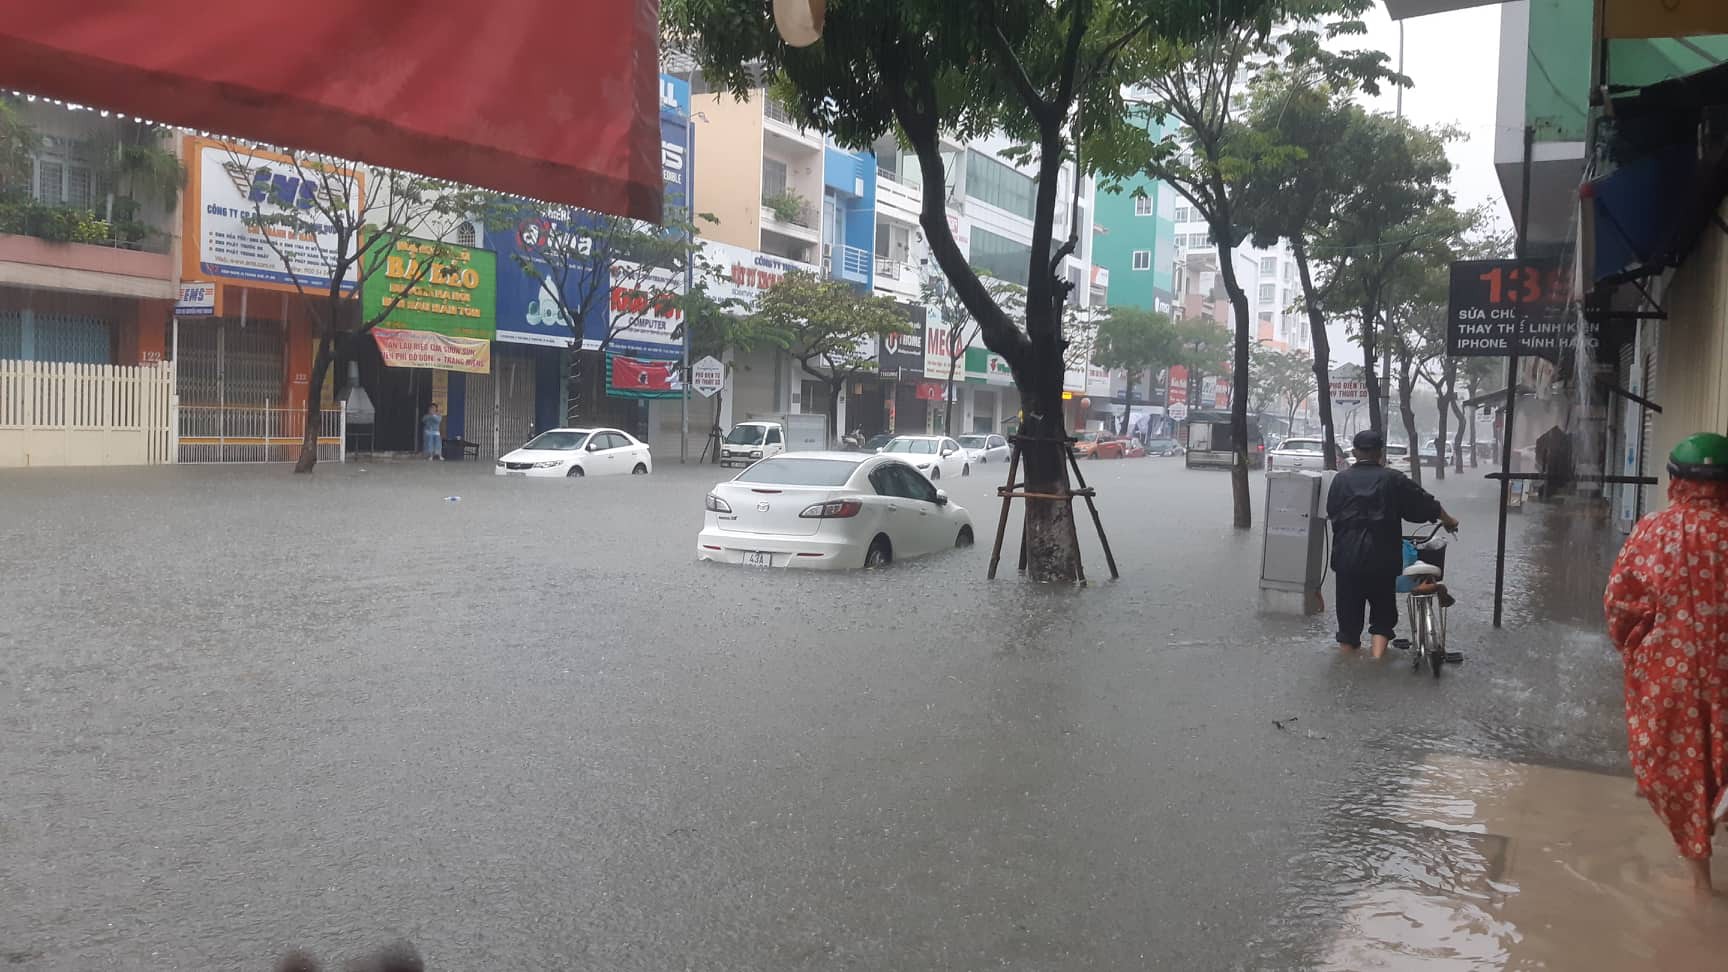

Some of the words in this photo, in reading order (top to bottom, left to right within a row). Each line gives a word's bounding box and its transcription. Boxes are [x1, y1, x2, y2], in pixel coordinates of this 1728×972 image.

[248, 167, 318, 210] EMS
[183, 288, 205, 302] EMS
[1458, 306, 1486, 320] SỬA
[629, 316, 666, 330] COMPUTER
[1457, 323, 1493, 334] THAY
[1529, 323, 1561, 333] LINH
[1457, 337, 1508, 349] IPHONE
[1519, 336, 1555, 348] HÍNH
[142, 351, 161, 362] 122
[749, 553, 764, 565] 43A
